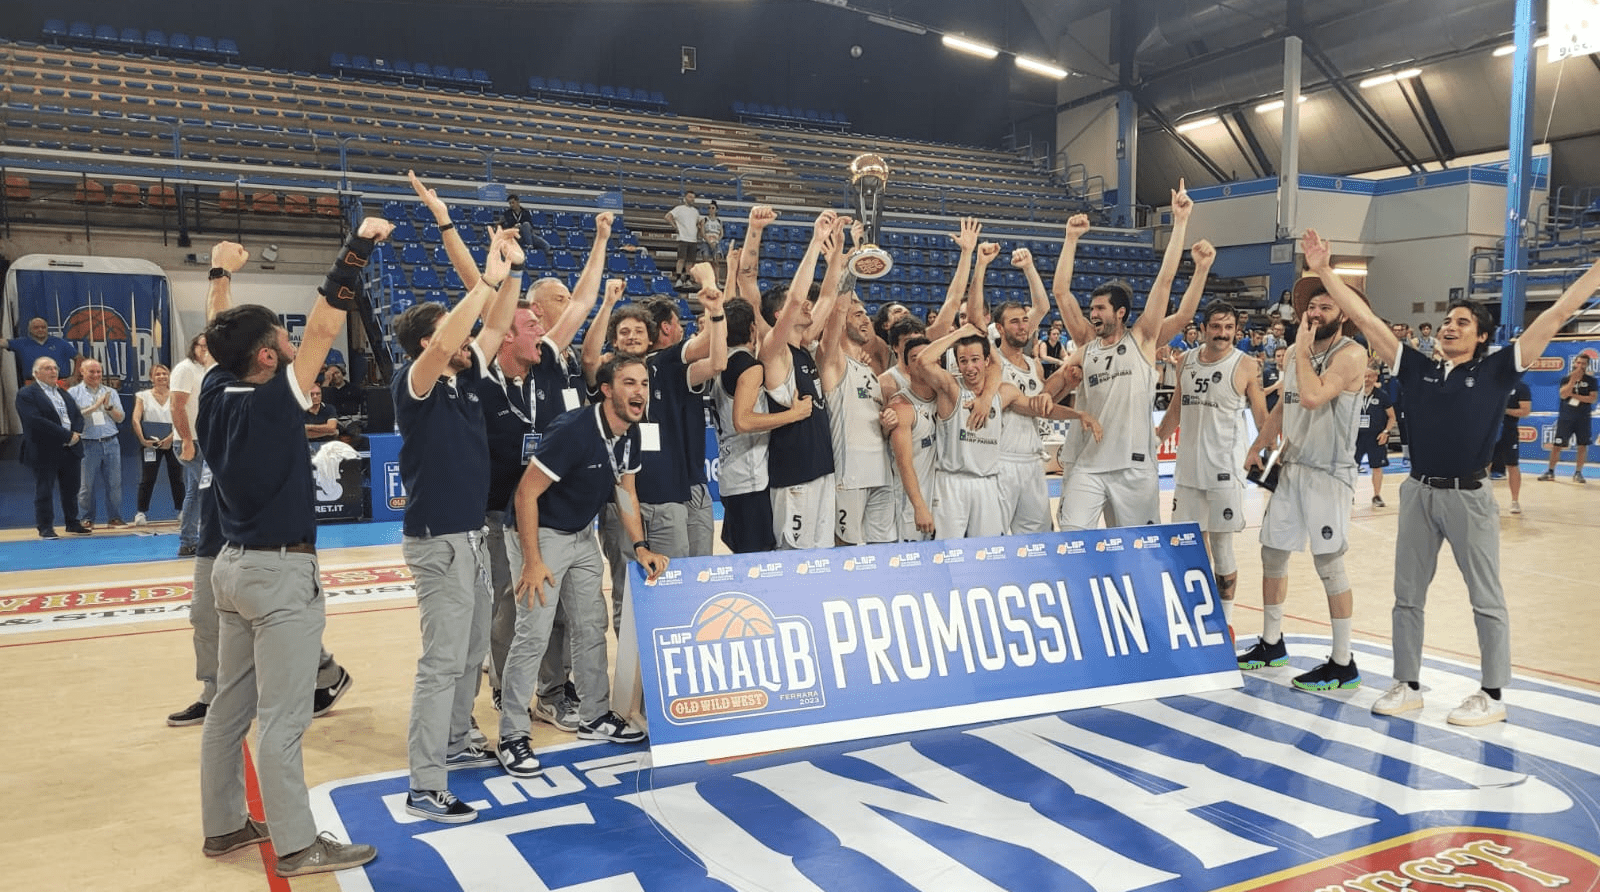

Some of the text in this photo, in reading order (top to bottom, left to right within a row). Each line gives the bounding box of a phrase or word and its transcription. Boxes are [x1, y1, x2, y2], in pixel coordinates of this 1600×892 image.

[1105, 356, 1113, 370] 7
[1194, 379, 1210, 393] 55
[792, 515, 802, 531] 5
[839, 509, 847, 525] 2
[709, 566, 733, 575] LNP
[759, 563, 783, 572] LNP
[807, 559, 830, 568] LNP
[853, 556, 876, 564] LNP
[943, 549, 963, 558] LNP
[822, 569, 1224, 689] PROMOSSI IN A2
[659, 632, 692, 645] LNP
[779, 690, 819, 701] FERRARA
[675, 693, 763, 715] OLD WILD WEST
